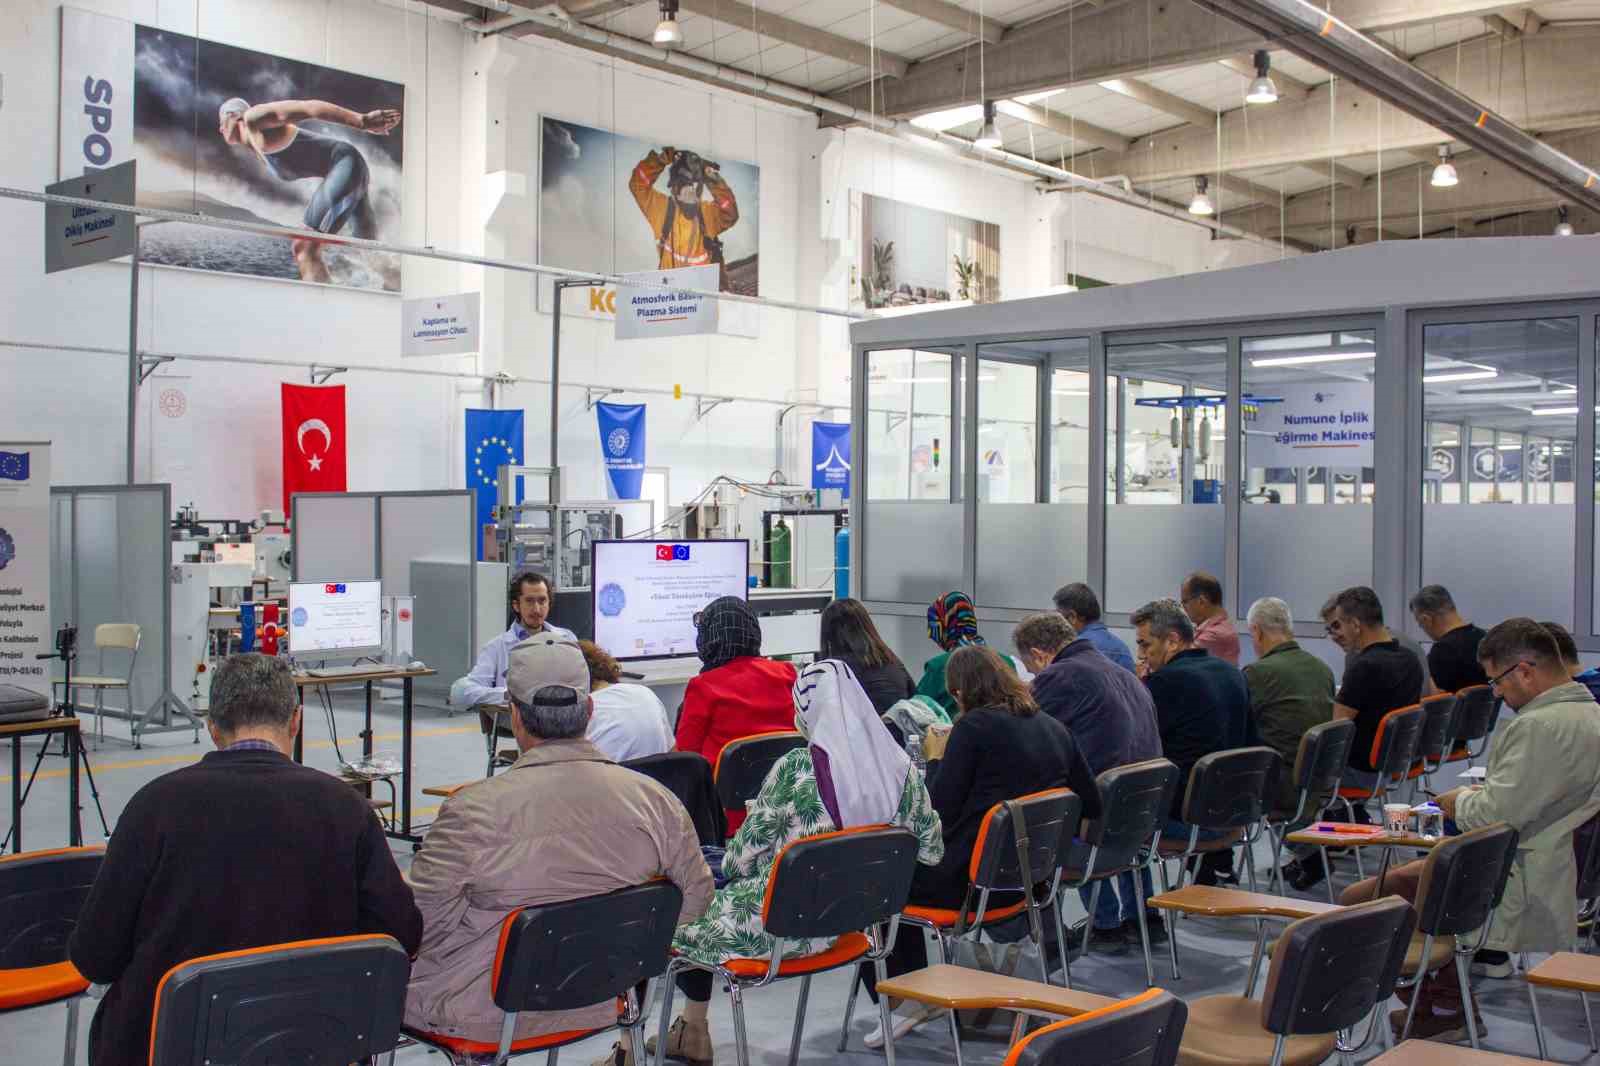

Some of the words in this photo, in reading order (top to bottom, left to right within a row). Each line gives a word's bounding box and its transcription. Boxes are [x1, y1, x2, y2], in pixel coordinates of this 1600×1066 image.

[83, 76, 112, 173] SPO
[631, 293, 676, 305] Atmosferik
[636, 306, 668, 317] Plazma
[669, 302, 698, 315] Sistemi
[1283, 414, 1337, 425] Numune
[1339, 410, 1370, 425] İplik
